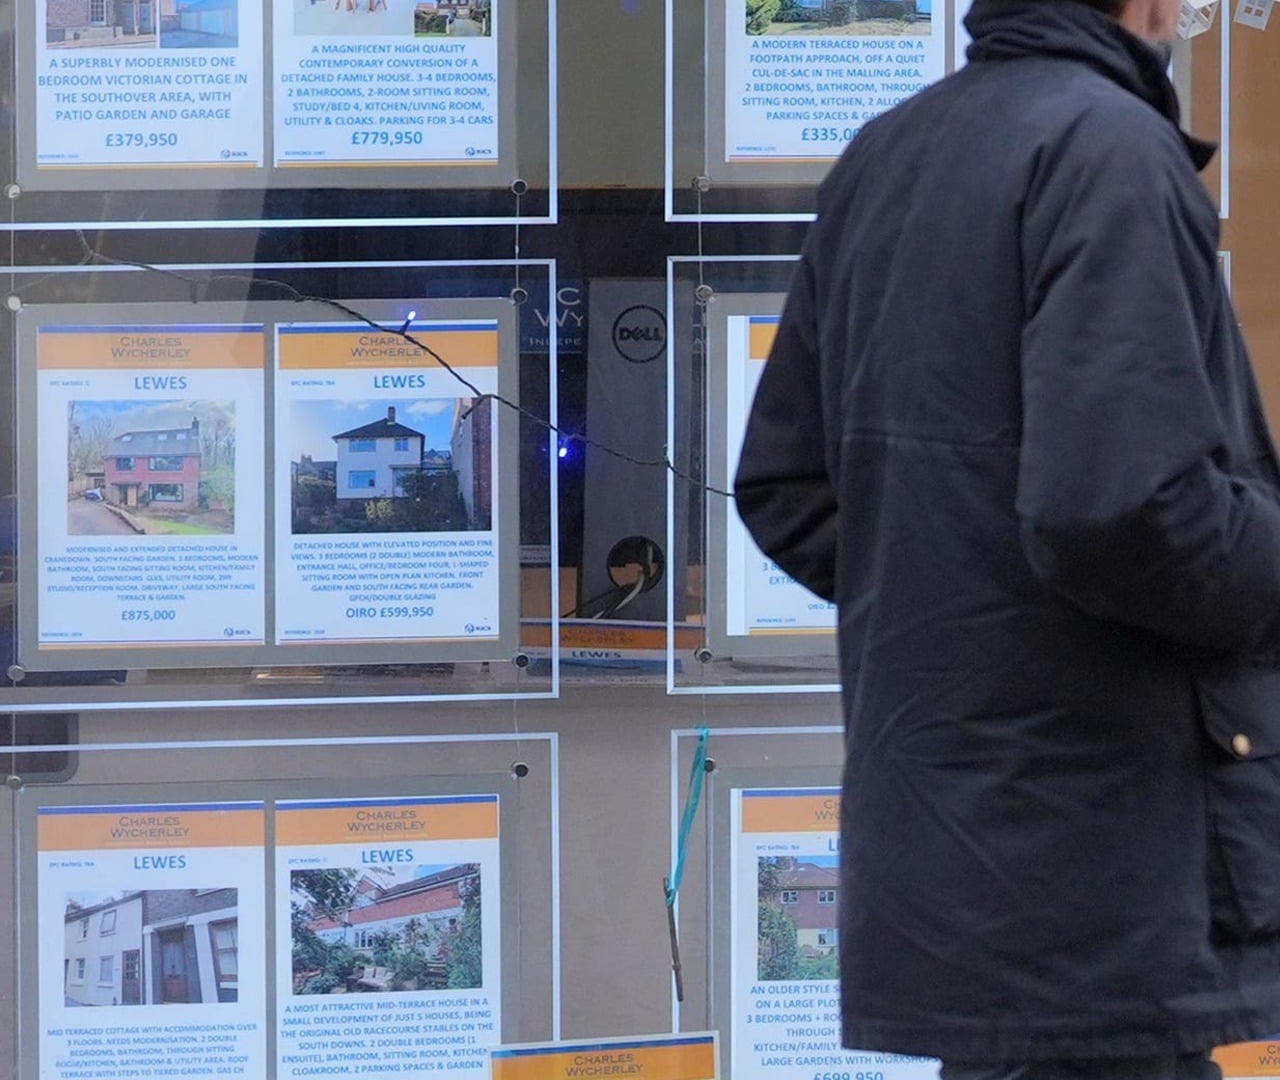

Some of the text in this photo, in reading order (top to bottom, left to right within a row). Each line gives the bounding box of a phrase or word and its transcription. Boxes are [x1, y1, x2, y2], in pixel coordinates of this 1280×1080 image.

[752, 40, 760, 48] A
[762, 40, 806, 49] MODERN
[810, 40, 860, 49] TERRACED
[862, 40, 895, 49] HOUSE
[898, 40, 913, 49] ON
[49, 56, 236, 68] A SUPERBLY MODERNISED ONE
[38, 74, 247, 86] BEDROOM VICTORIAN COTTAGE IN
[54, 92, 231, 104] THE SOUTHOVER AREA, WITH
[56, 108, 230, 120] PATIO GARDEN AND GARAGE
[106, 133, 178, 148] £379,950
[352, 131, 422, 146] £779,950
[619, 326, 662, 342] DELL
[135, 376, 187, 390] LEWES
[374, 375, 426, 388] LEWES
[122, 610, 176, 622] £875,000
[346, 606, 434, 618] OIRO £599,950
[356, 810, 416, 820] CHARLES
[347, 821, 425, 832] WYCHERLEY
[362, 849, 414, 863] LEWES
[134, 856, 186, 870] LEWES
[574, 1054, 633, 1066] CHARLES
[566, 1064, 642, 1077] WYCHERLEY
